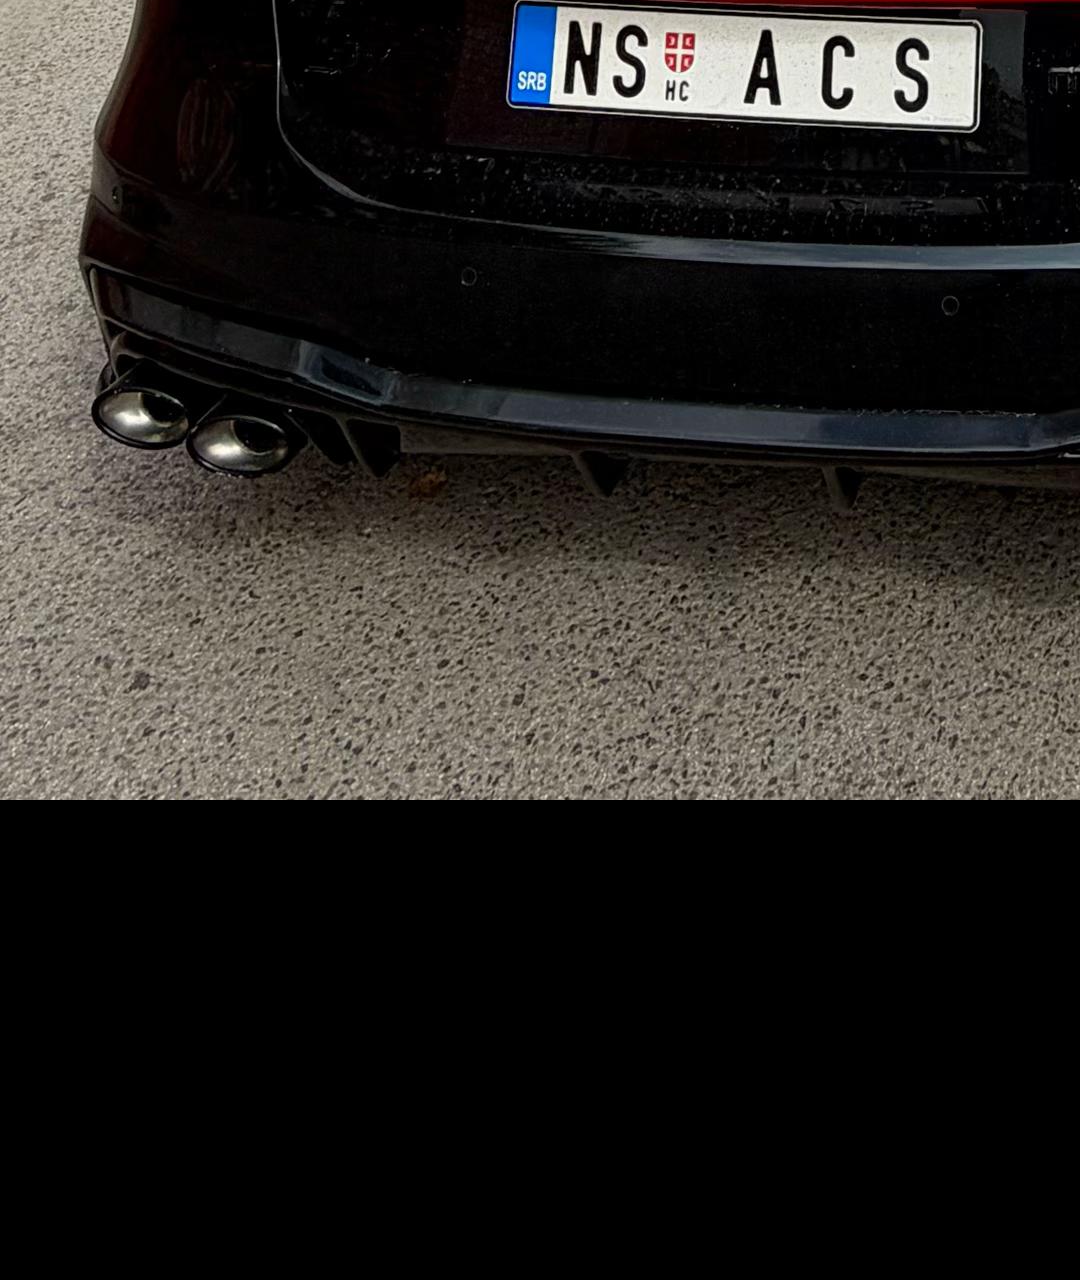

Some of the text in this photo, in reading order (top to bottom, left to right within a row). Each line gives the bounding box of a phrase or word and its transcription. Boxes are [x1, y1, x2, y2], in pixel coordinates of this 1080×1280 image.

[517, 71, 547, 91] SRB
[563, 20, 930, 113] NS ACS
